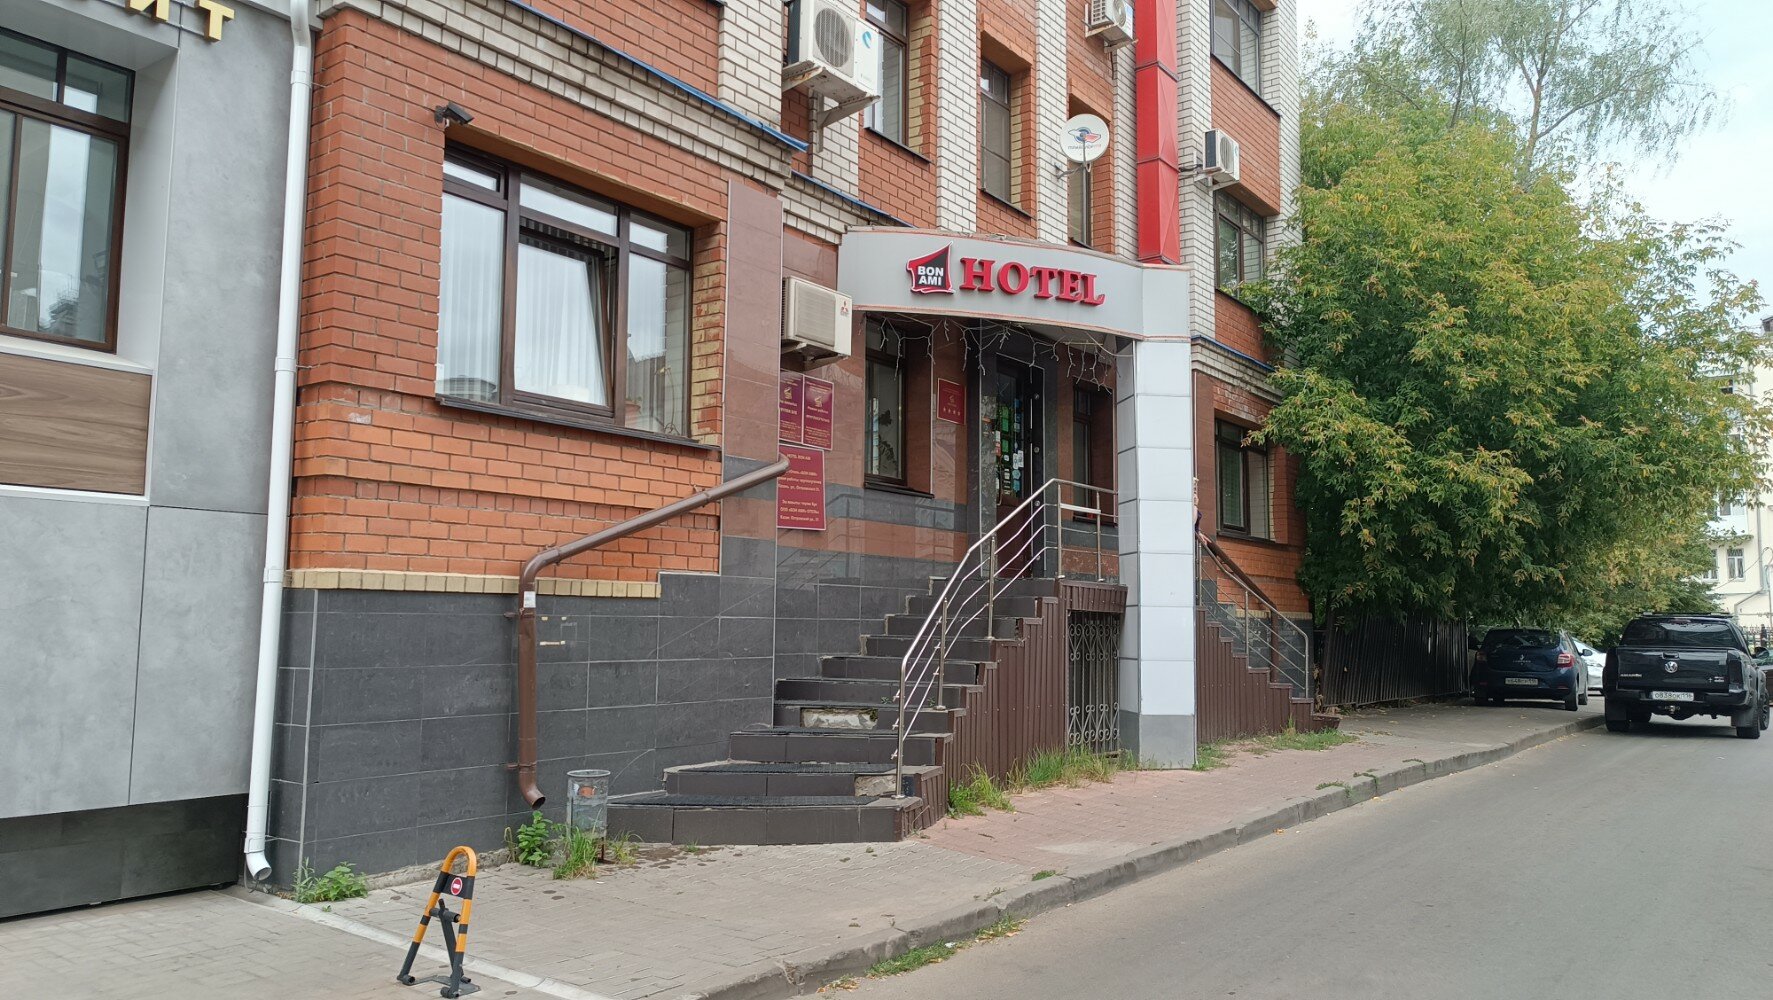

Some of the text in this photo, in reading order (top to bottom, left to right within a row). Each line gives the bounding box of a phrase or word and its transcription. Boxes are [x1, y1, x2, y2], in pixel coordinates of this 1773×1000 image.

[917, 265, 944, 277] BON
[918, 275, 942, 286] AMI
[959, 257, 1106, 306] HOTEL
